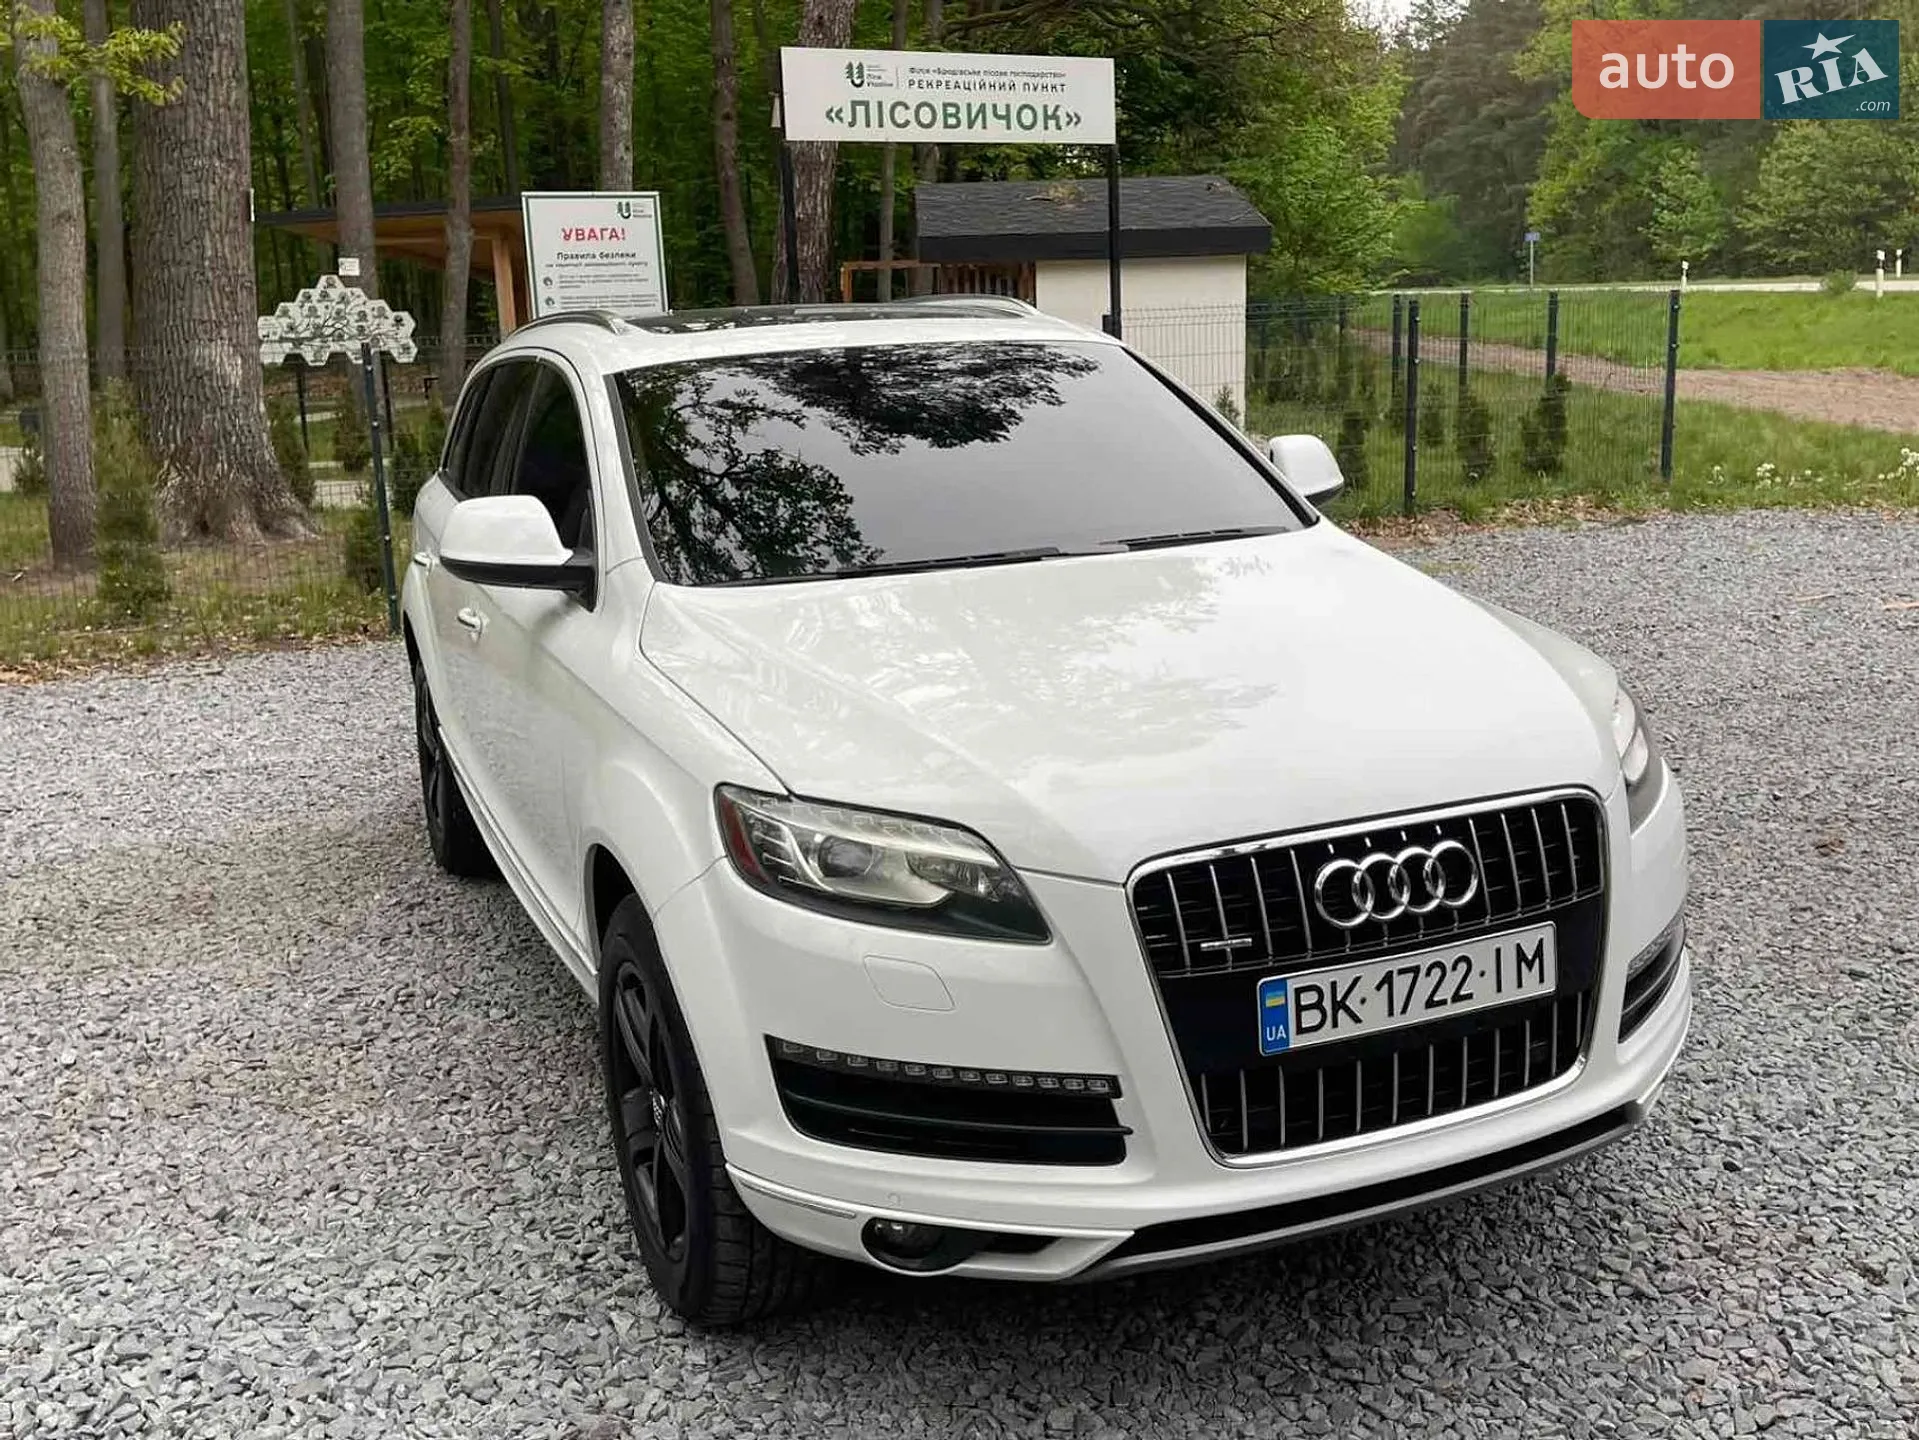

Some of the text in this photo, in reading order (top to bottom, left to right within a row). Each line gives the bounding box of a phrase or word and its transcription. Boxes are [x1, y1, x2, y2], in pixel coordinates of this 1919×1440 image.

[908, 78, 1017, 93] РЕКРЕАЦІЙНИЙ
[1022, 82, 1067, 93] ПУНКТ
[825, 99, 1082, 131] «ЛІСОВИЧОК»
[561, 227, 626, 242] УВАГА!
[1293, 936, 1545, 1036] BK 1722 IM
[1266, 1024, 1287, 1042] UA
